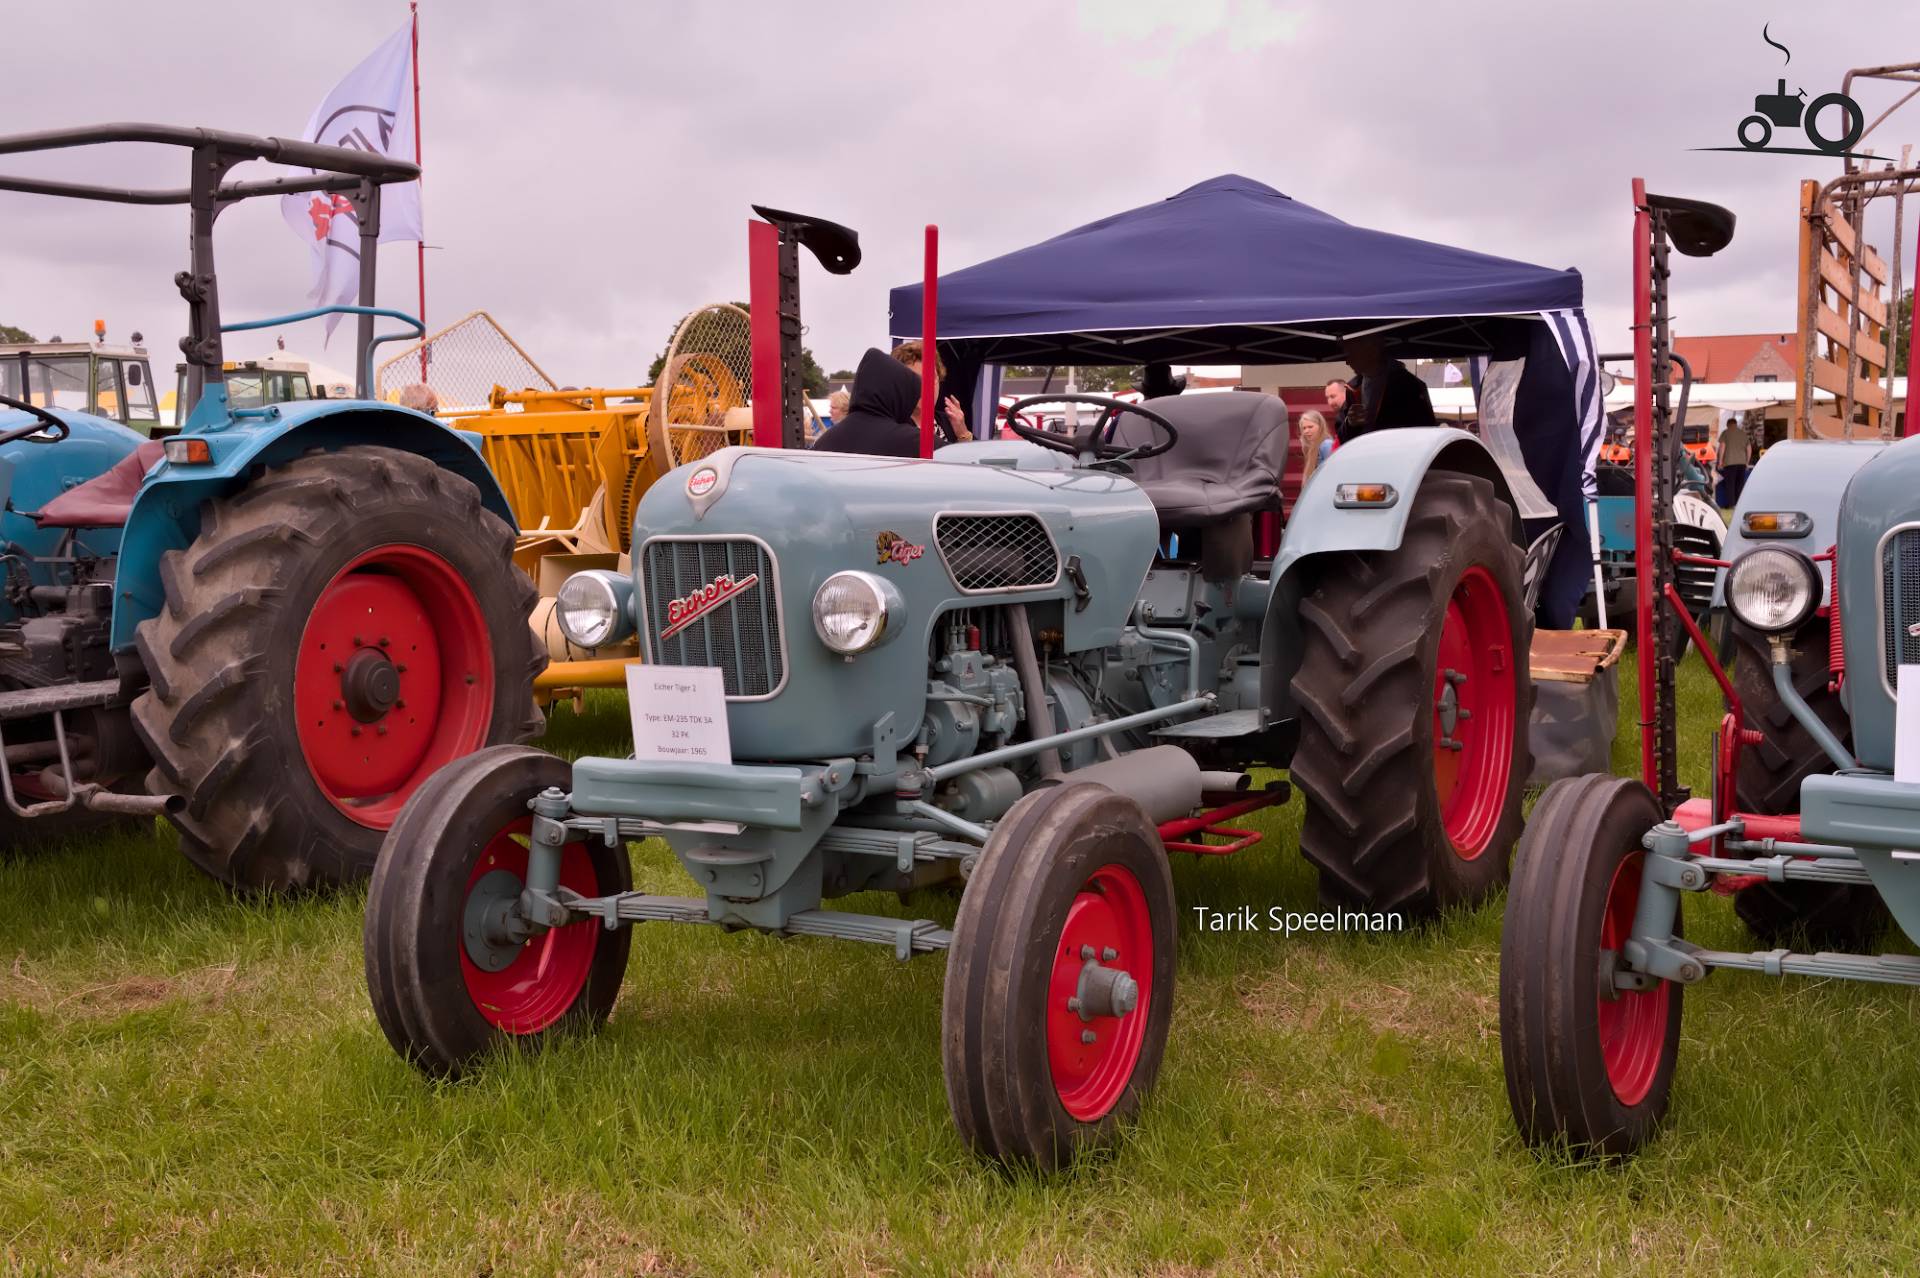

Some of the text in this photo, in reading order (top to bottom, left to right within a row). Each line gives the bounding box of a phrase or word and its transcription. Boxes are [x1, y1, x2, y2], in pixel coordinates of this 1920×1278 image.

[891, 540, 925, 566] Tiger
[668, 574, 734, 624] Eicher
[654, 683, 673, 691] Eicher
[675, 684, 691, 692] Tiger
[691, 747, 707, 756] 1965
